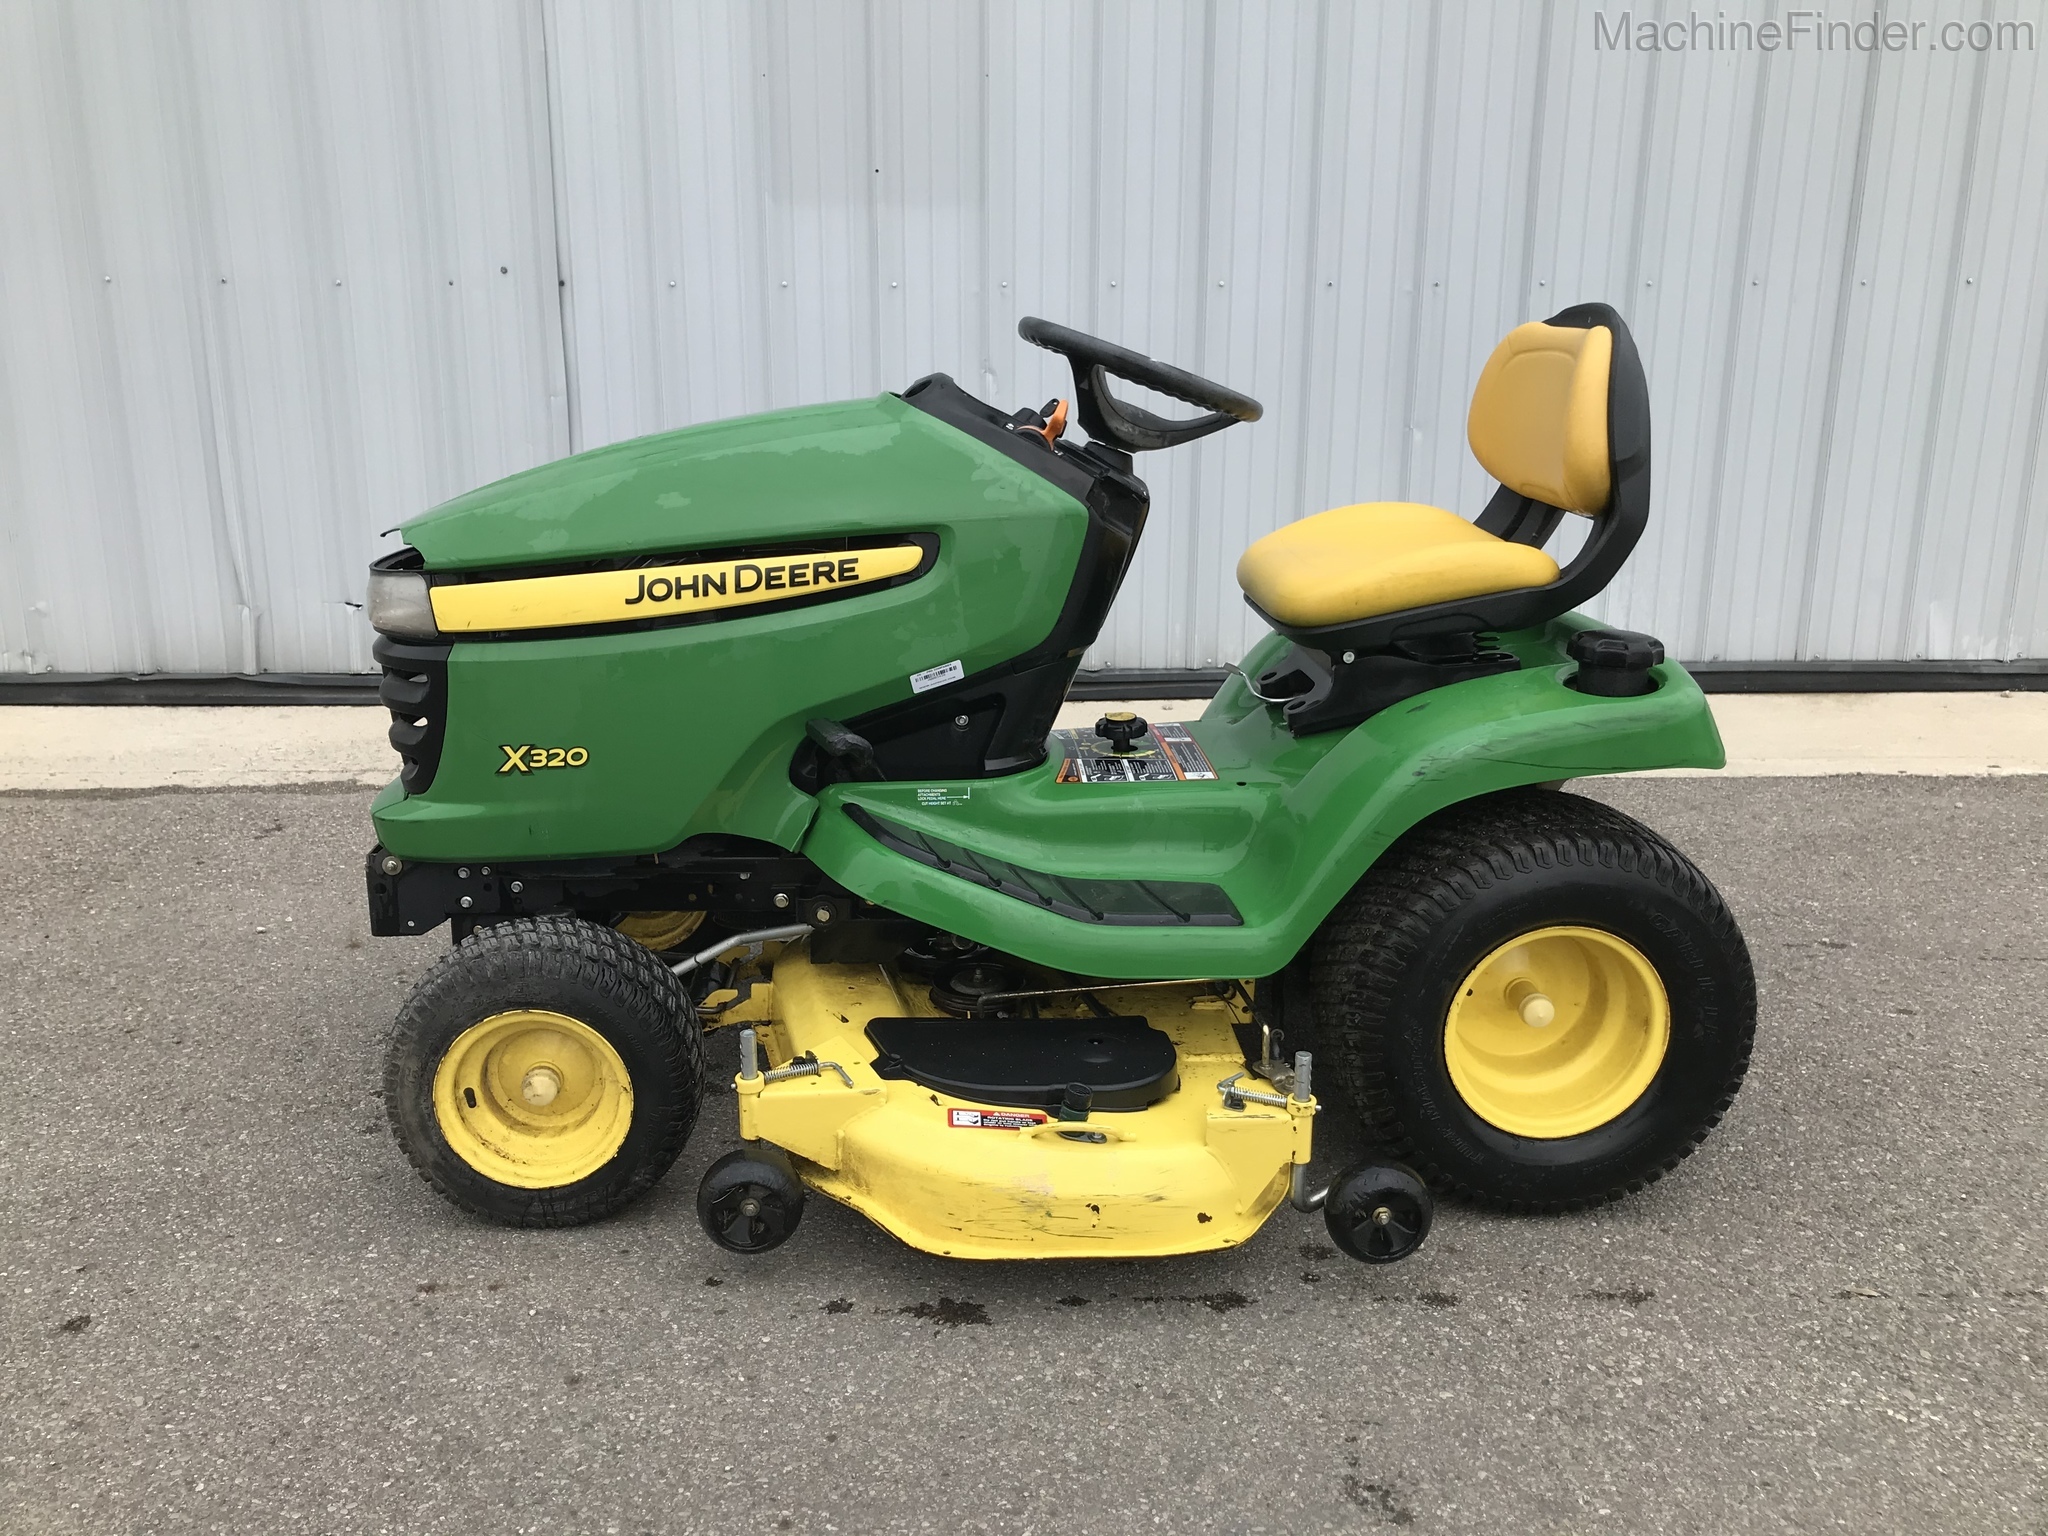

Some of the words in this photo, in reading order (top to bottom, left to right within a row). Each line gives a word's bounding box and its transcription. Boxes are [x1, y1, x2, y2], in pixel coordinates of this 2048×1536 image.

[625, 572, 727, 605] JOHN
[734, 557, 859, 594] DEERE
[498, 744, 589, 773] X320
